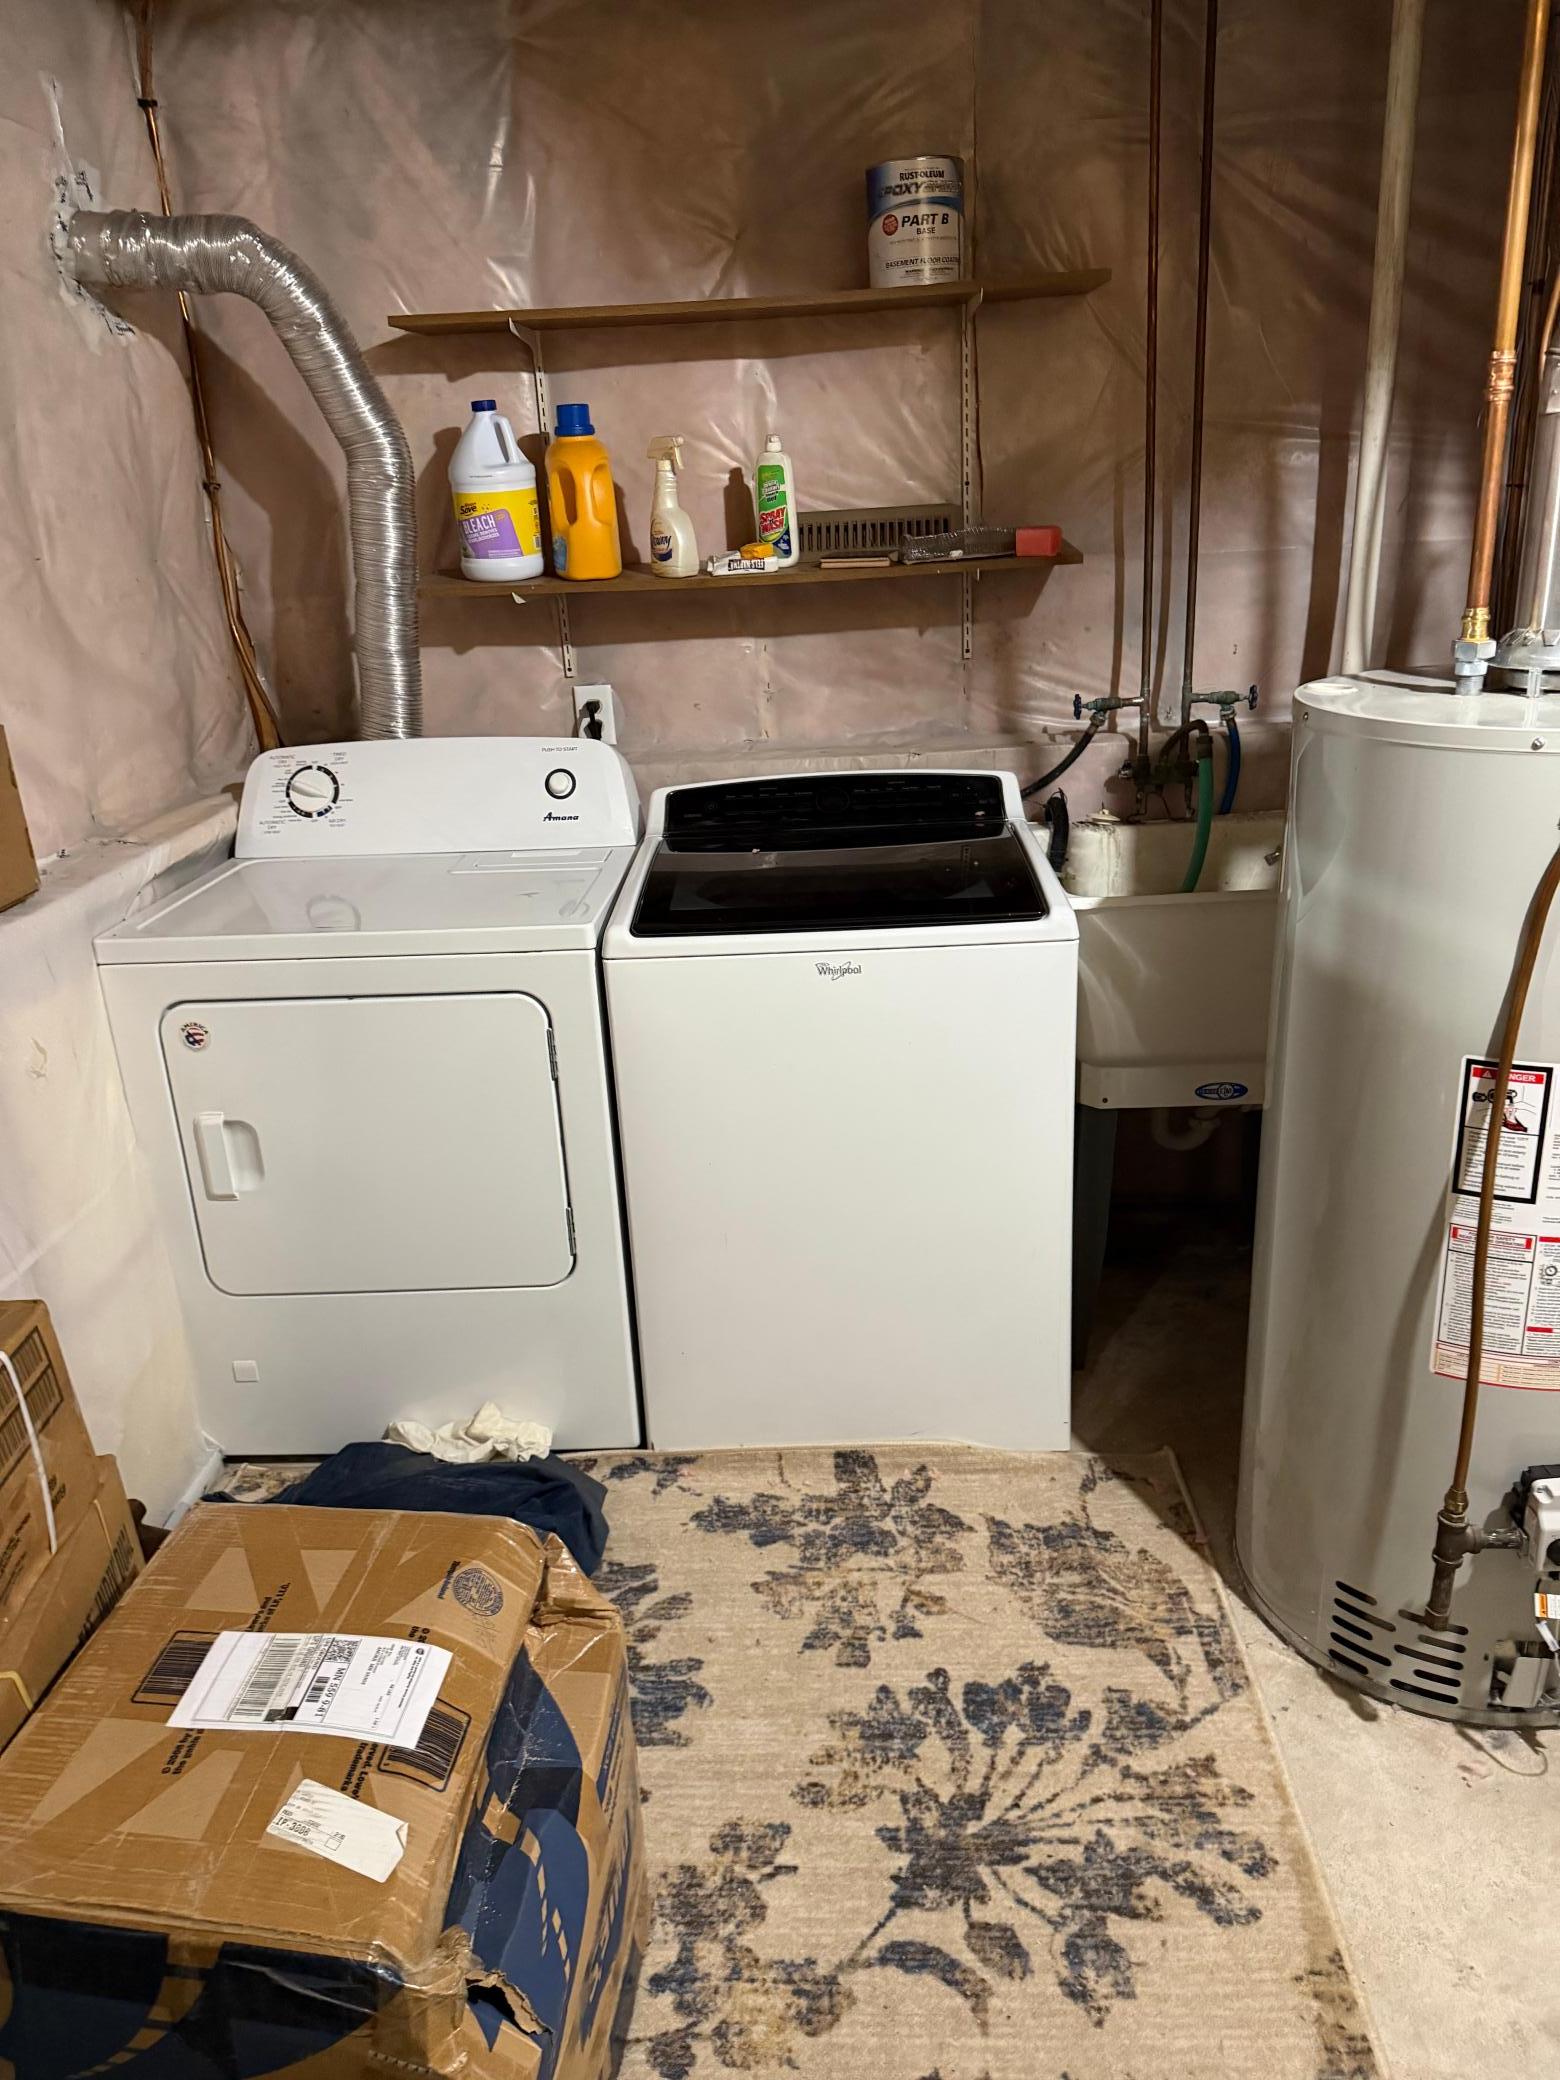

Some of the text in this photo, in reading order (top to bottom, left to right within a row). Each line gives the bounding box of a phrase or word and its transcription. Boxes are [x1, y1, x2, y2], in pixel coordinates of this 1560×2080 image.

[899, 170, 945, 181] RUST-OLEUM
[901, 213, 949, 227] PART B
[916, 227, 936, 235] BASE
[885, 258, 919, 269] BASEMENT
[463, 514, 497, 534] BLEACH
[543, 811, 579, 822] Amana
[815, 961, 862, 980] Whirlpool
[181, 1022, 209, 1034] AMERICA
[1508, 1073, 1537, 1083] NGER
[332, 1667, 346, 1681] MN
[340, 1743, 368, 1791] trademarks
[352, 1771, 369, 1799] Lowe'
